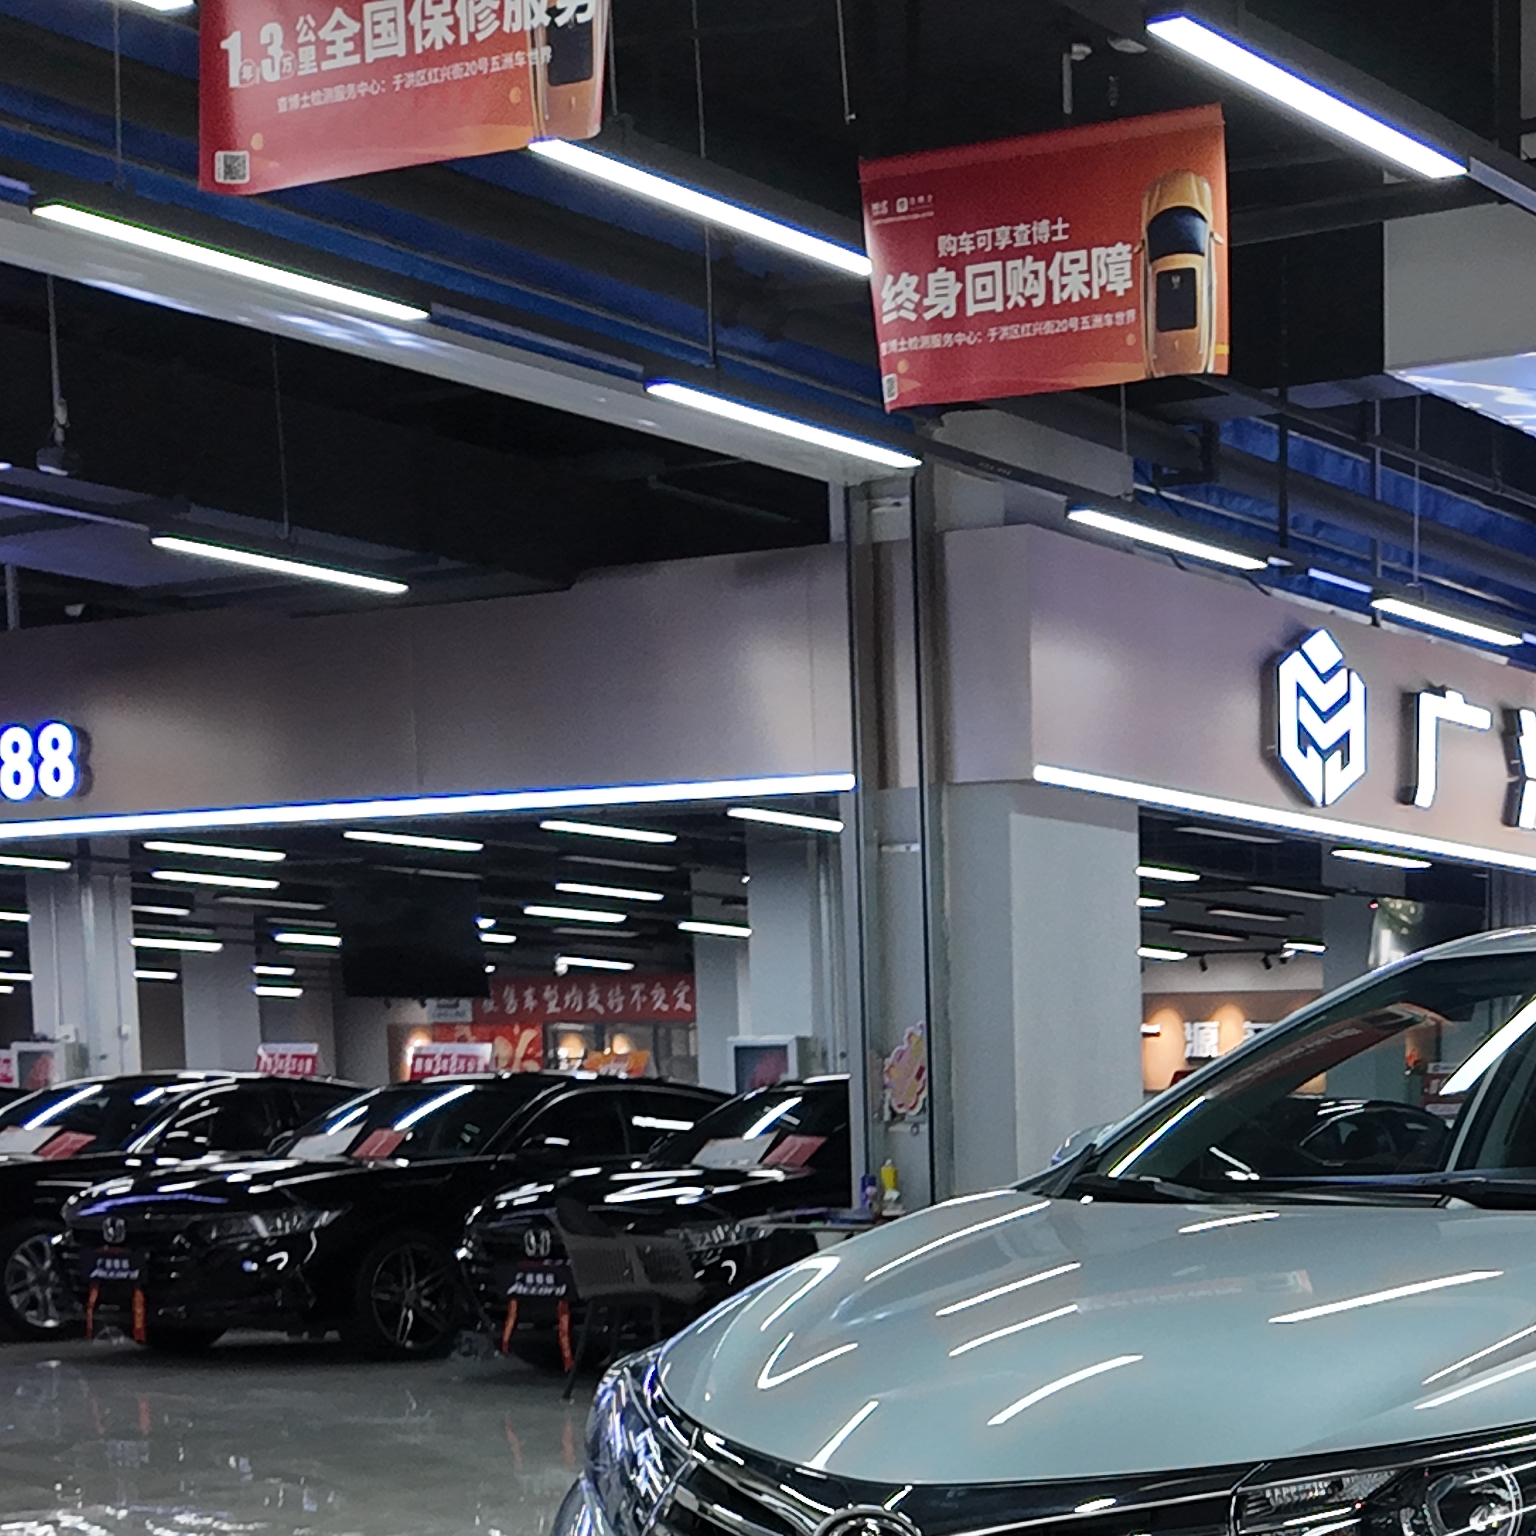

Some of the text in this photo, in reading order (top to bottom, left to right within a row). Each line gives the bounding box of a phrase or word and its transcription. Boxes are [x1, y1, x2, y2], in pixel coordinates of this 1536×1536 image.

[937, 216, 1071, 258] 购车可享查博士
[881, 242, 1134, 325] 终身回购保障
